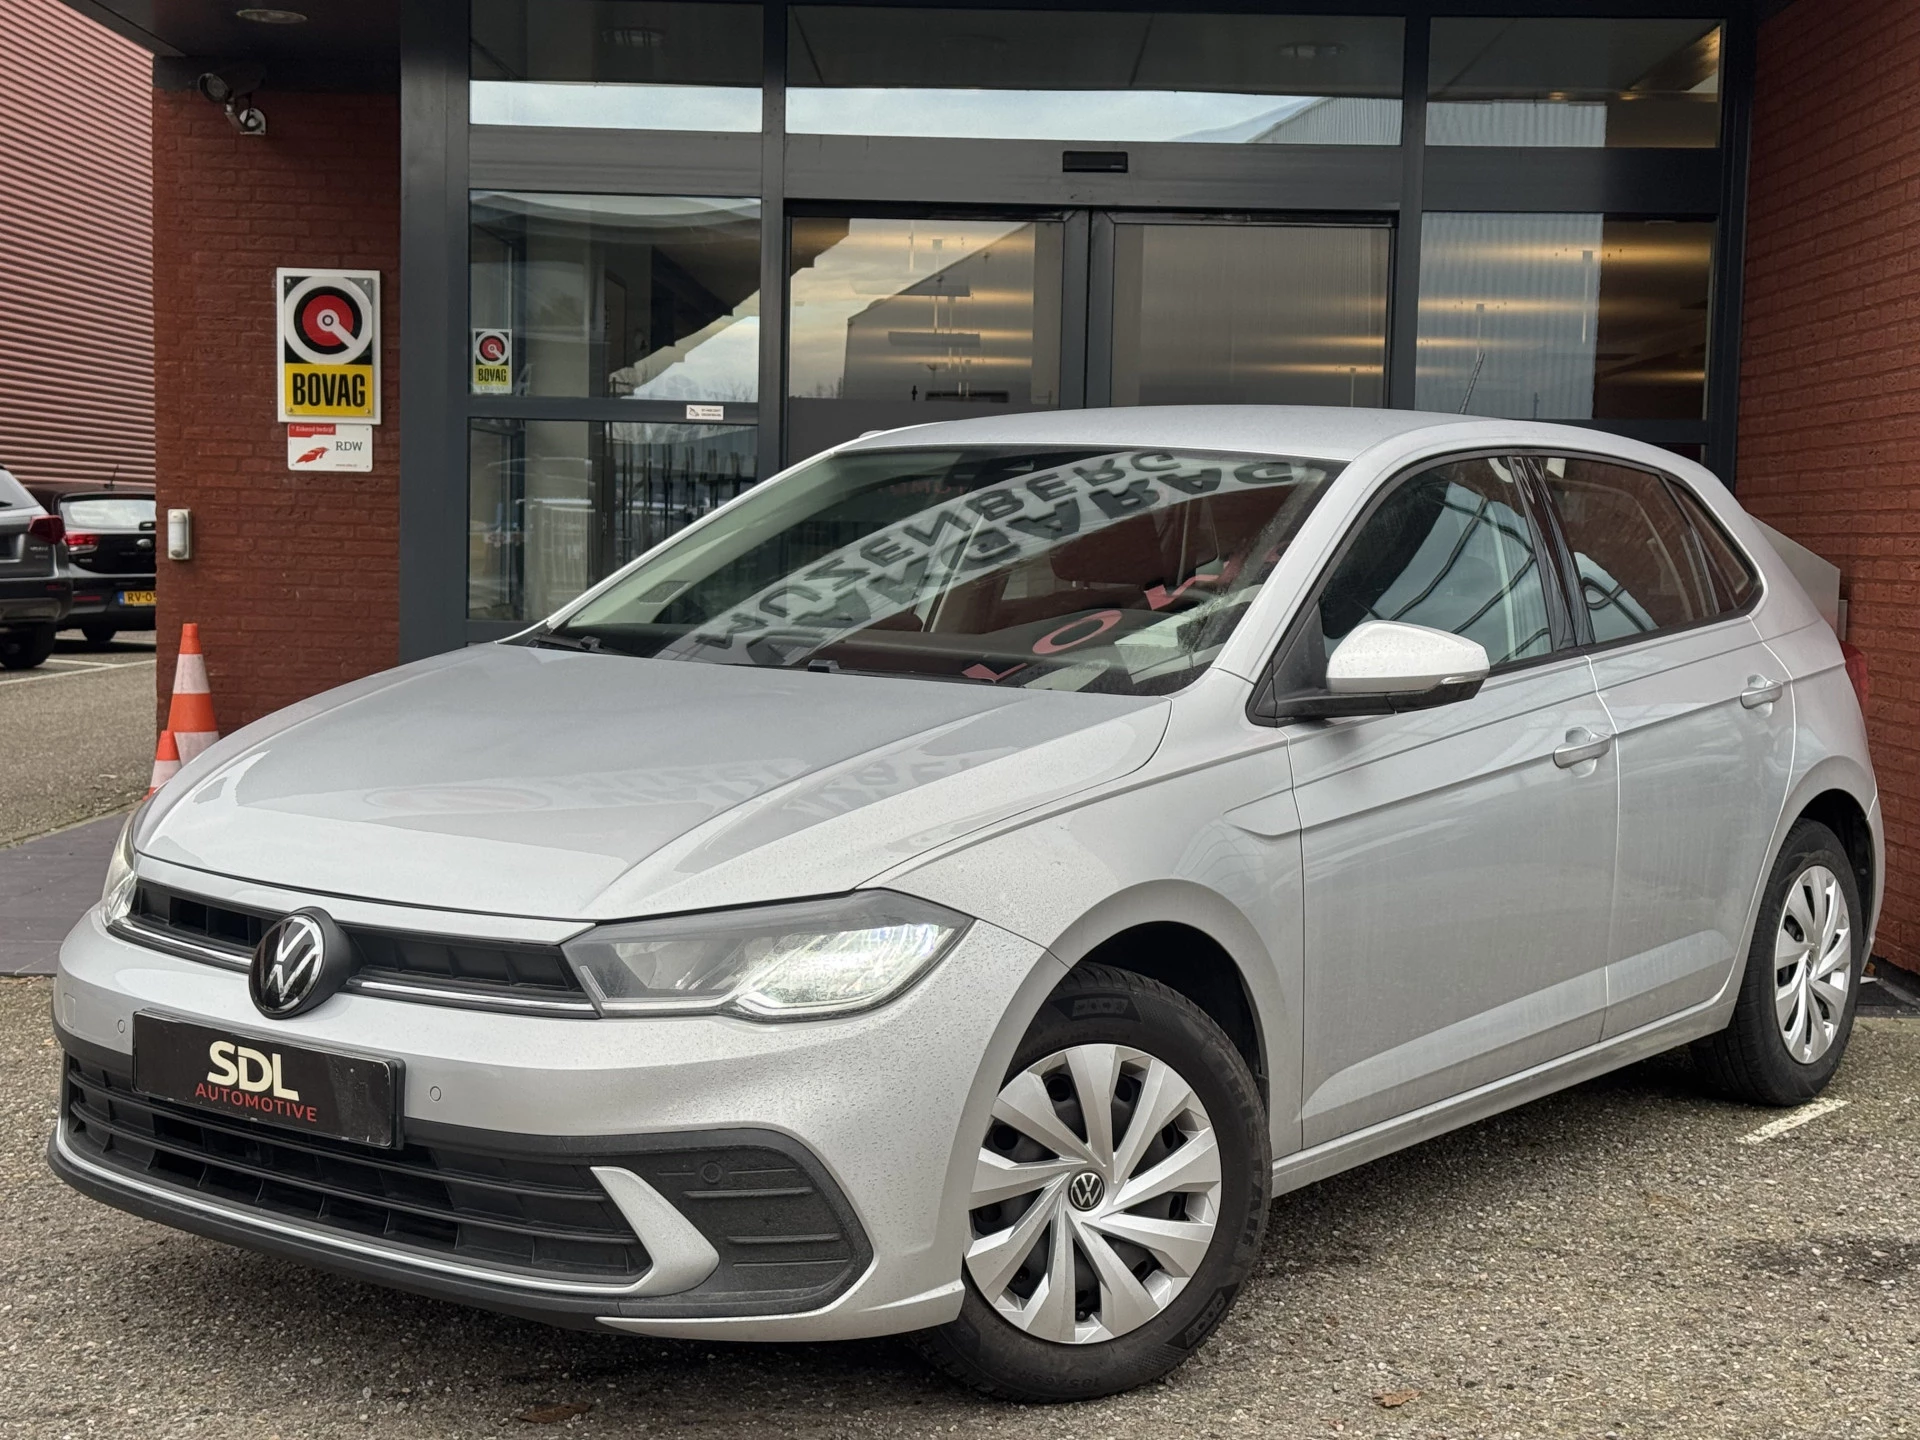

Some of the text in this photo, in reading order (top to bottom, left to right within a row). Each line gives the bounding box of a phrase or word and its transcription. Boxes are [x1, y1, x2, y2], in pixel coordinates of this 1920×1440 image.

[292, 373, 366, 408] BOVAG
[478, 368, 507, 382] BOVAG
[335, 440, 363, 452] RDW
[206, 1040, 300, 1102] SDL
[195, 1082, 318, 1123] AUTOMOTIVE
